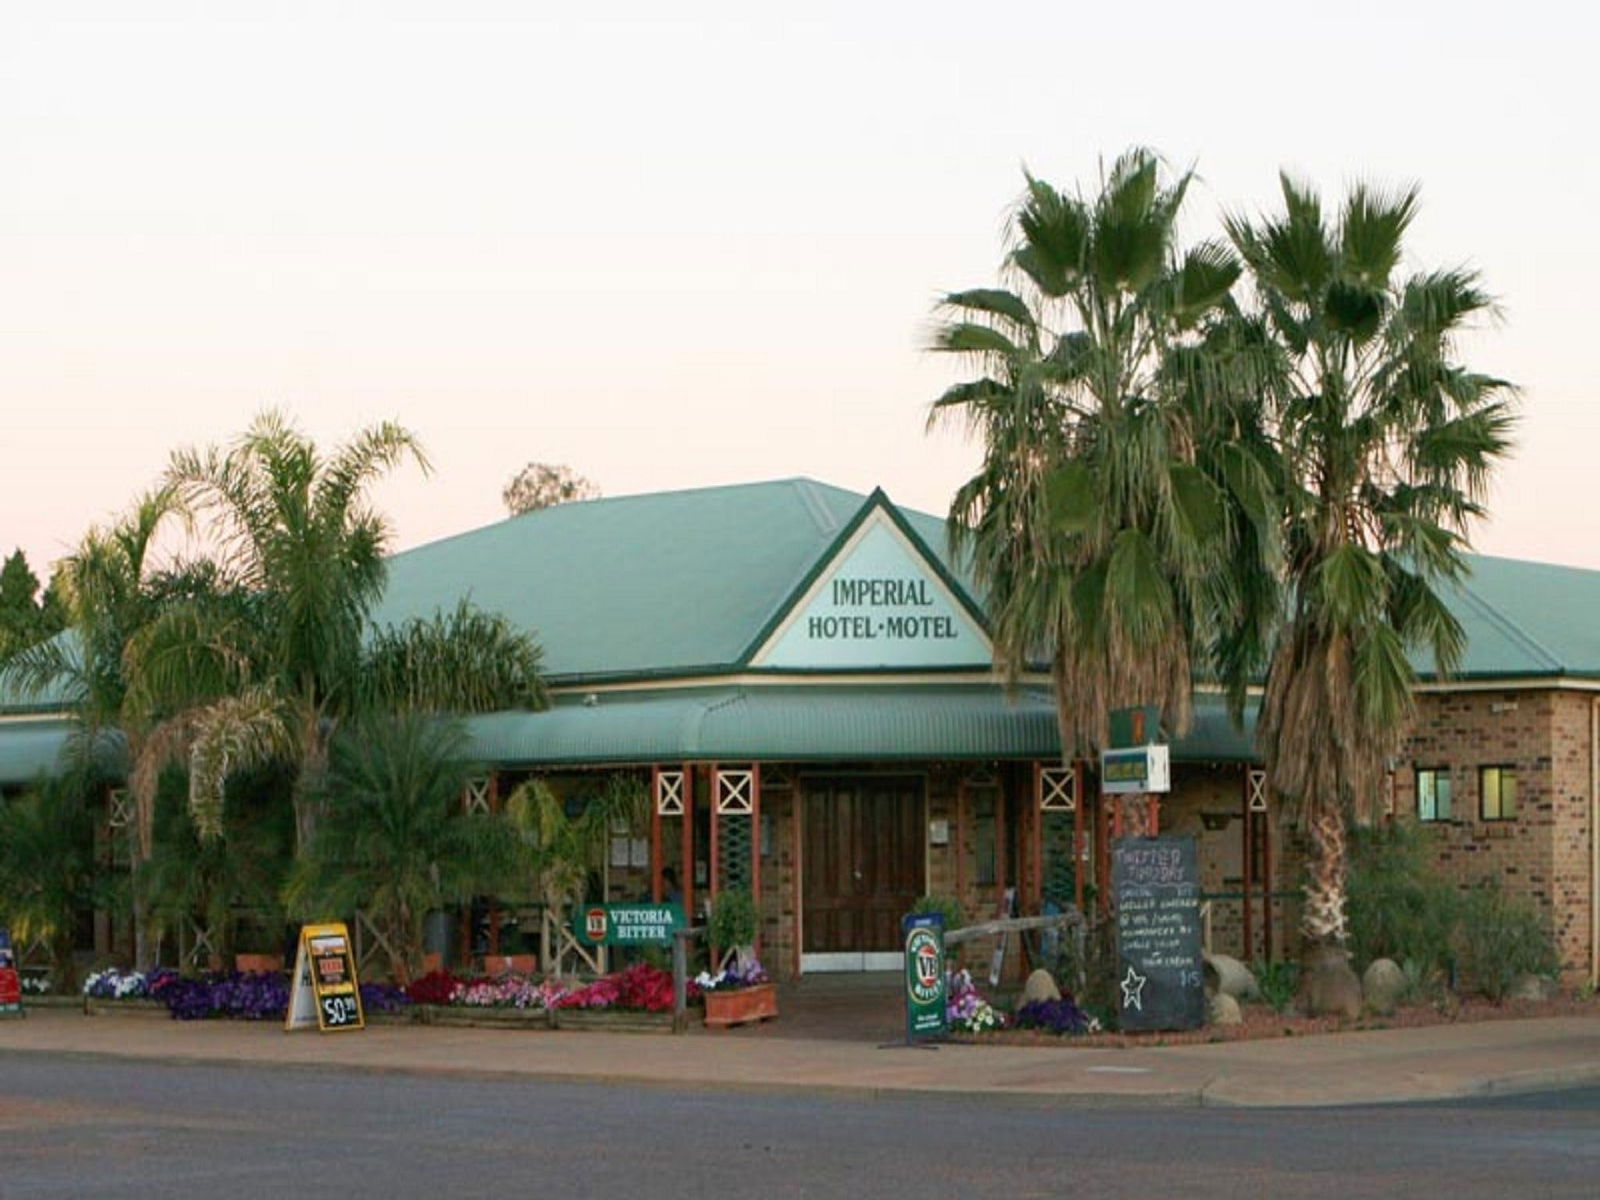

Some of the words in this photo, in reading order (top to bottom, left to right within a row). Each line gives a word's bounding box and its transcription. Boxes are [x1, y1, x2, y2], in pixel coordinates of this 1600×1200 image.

[833, 579, 934, 606] IMPERIAL
[610, 908, 673, 925] VICTORIA
[617, 925, 666, 939] BITTER
